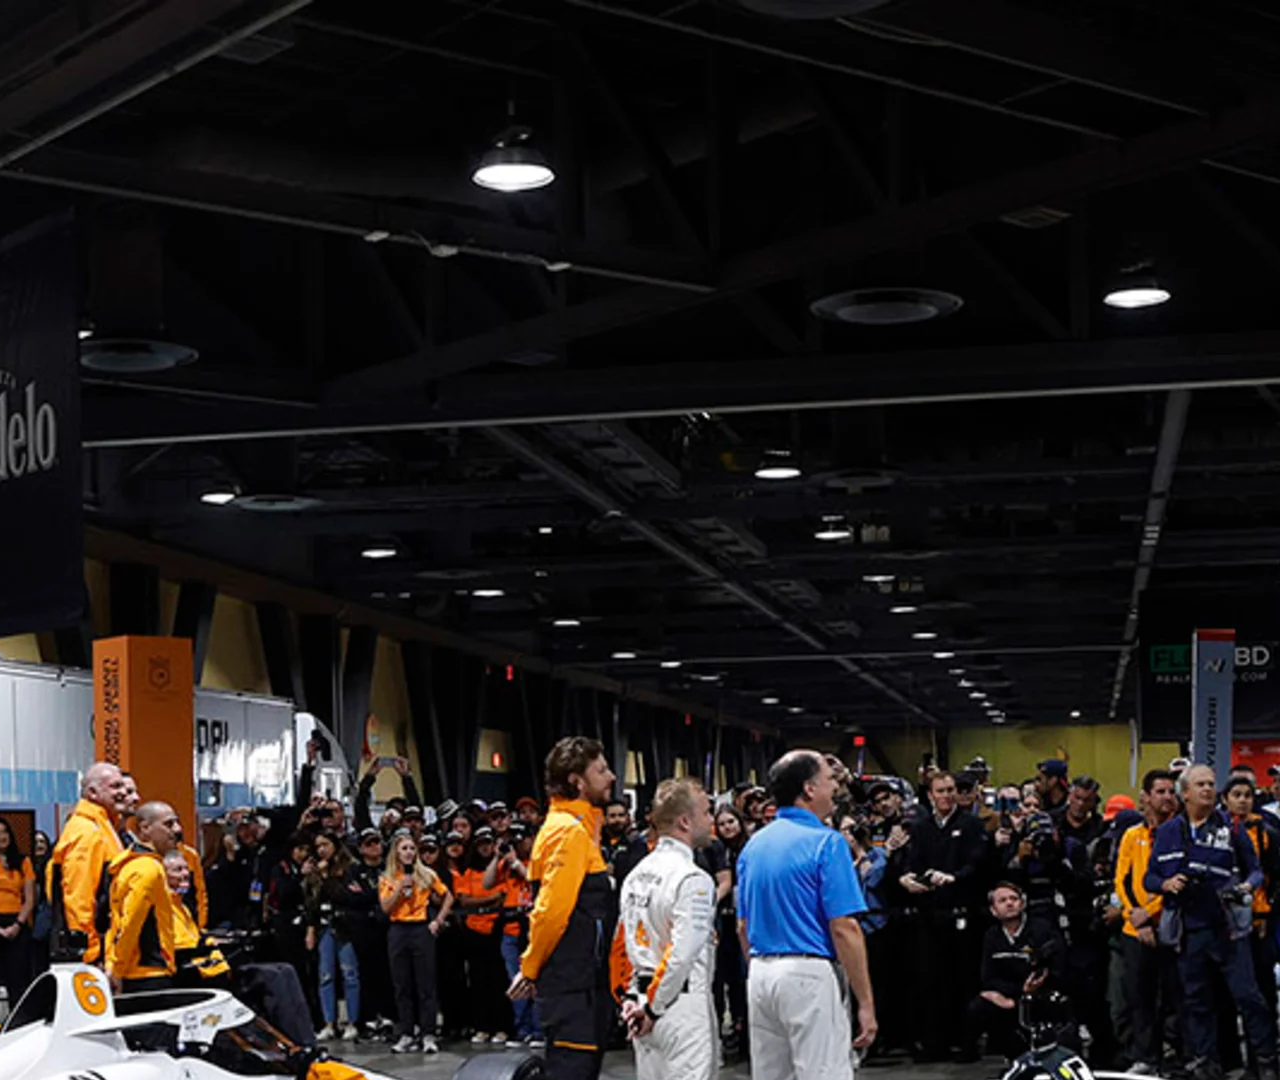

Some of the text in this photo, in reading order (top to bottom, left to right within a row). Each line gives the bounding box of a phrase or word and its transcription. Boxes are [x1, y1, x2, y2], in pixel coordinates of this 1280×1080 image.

[1234, 646, 1270, 666] BD
[1205, 697, 1218, 767] YUNDAI
[73, 971, 108, 1016] 6
